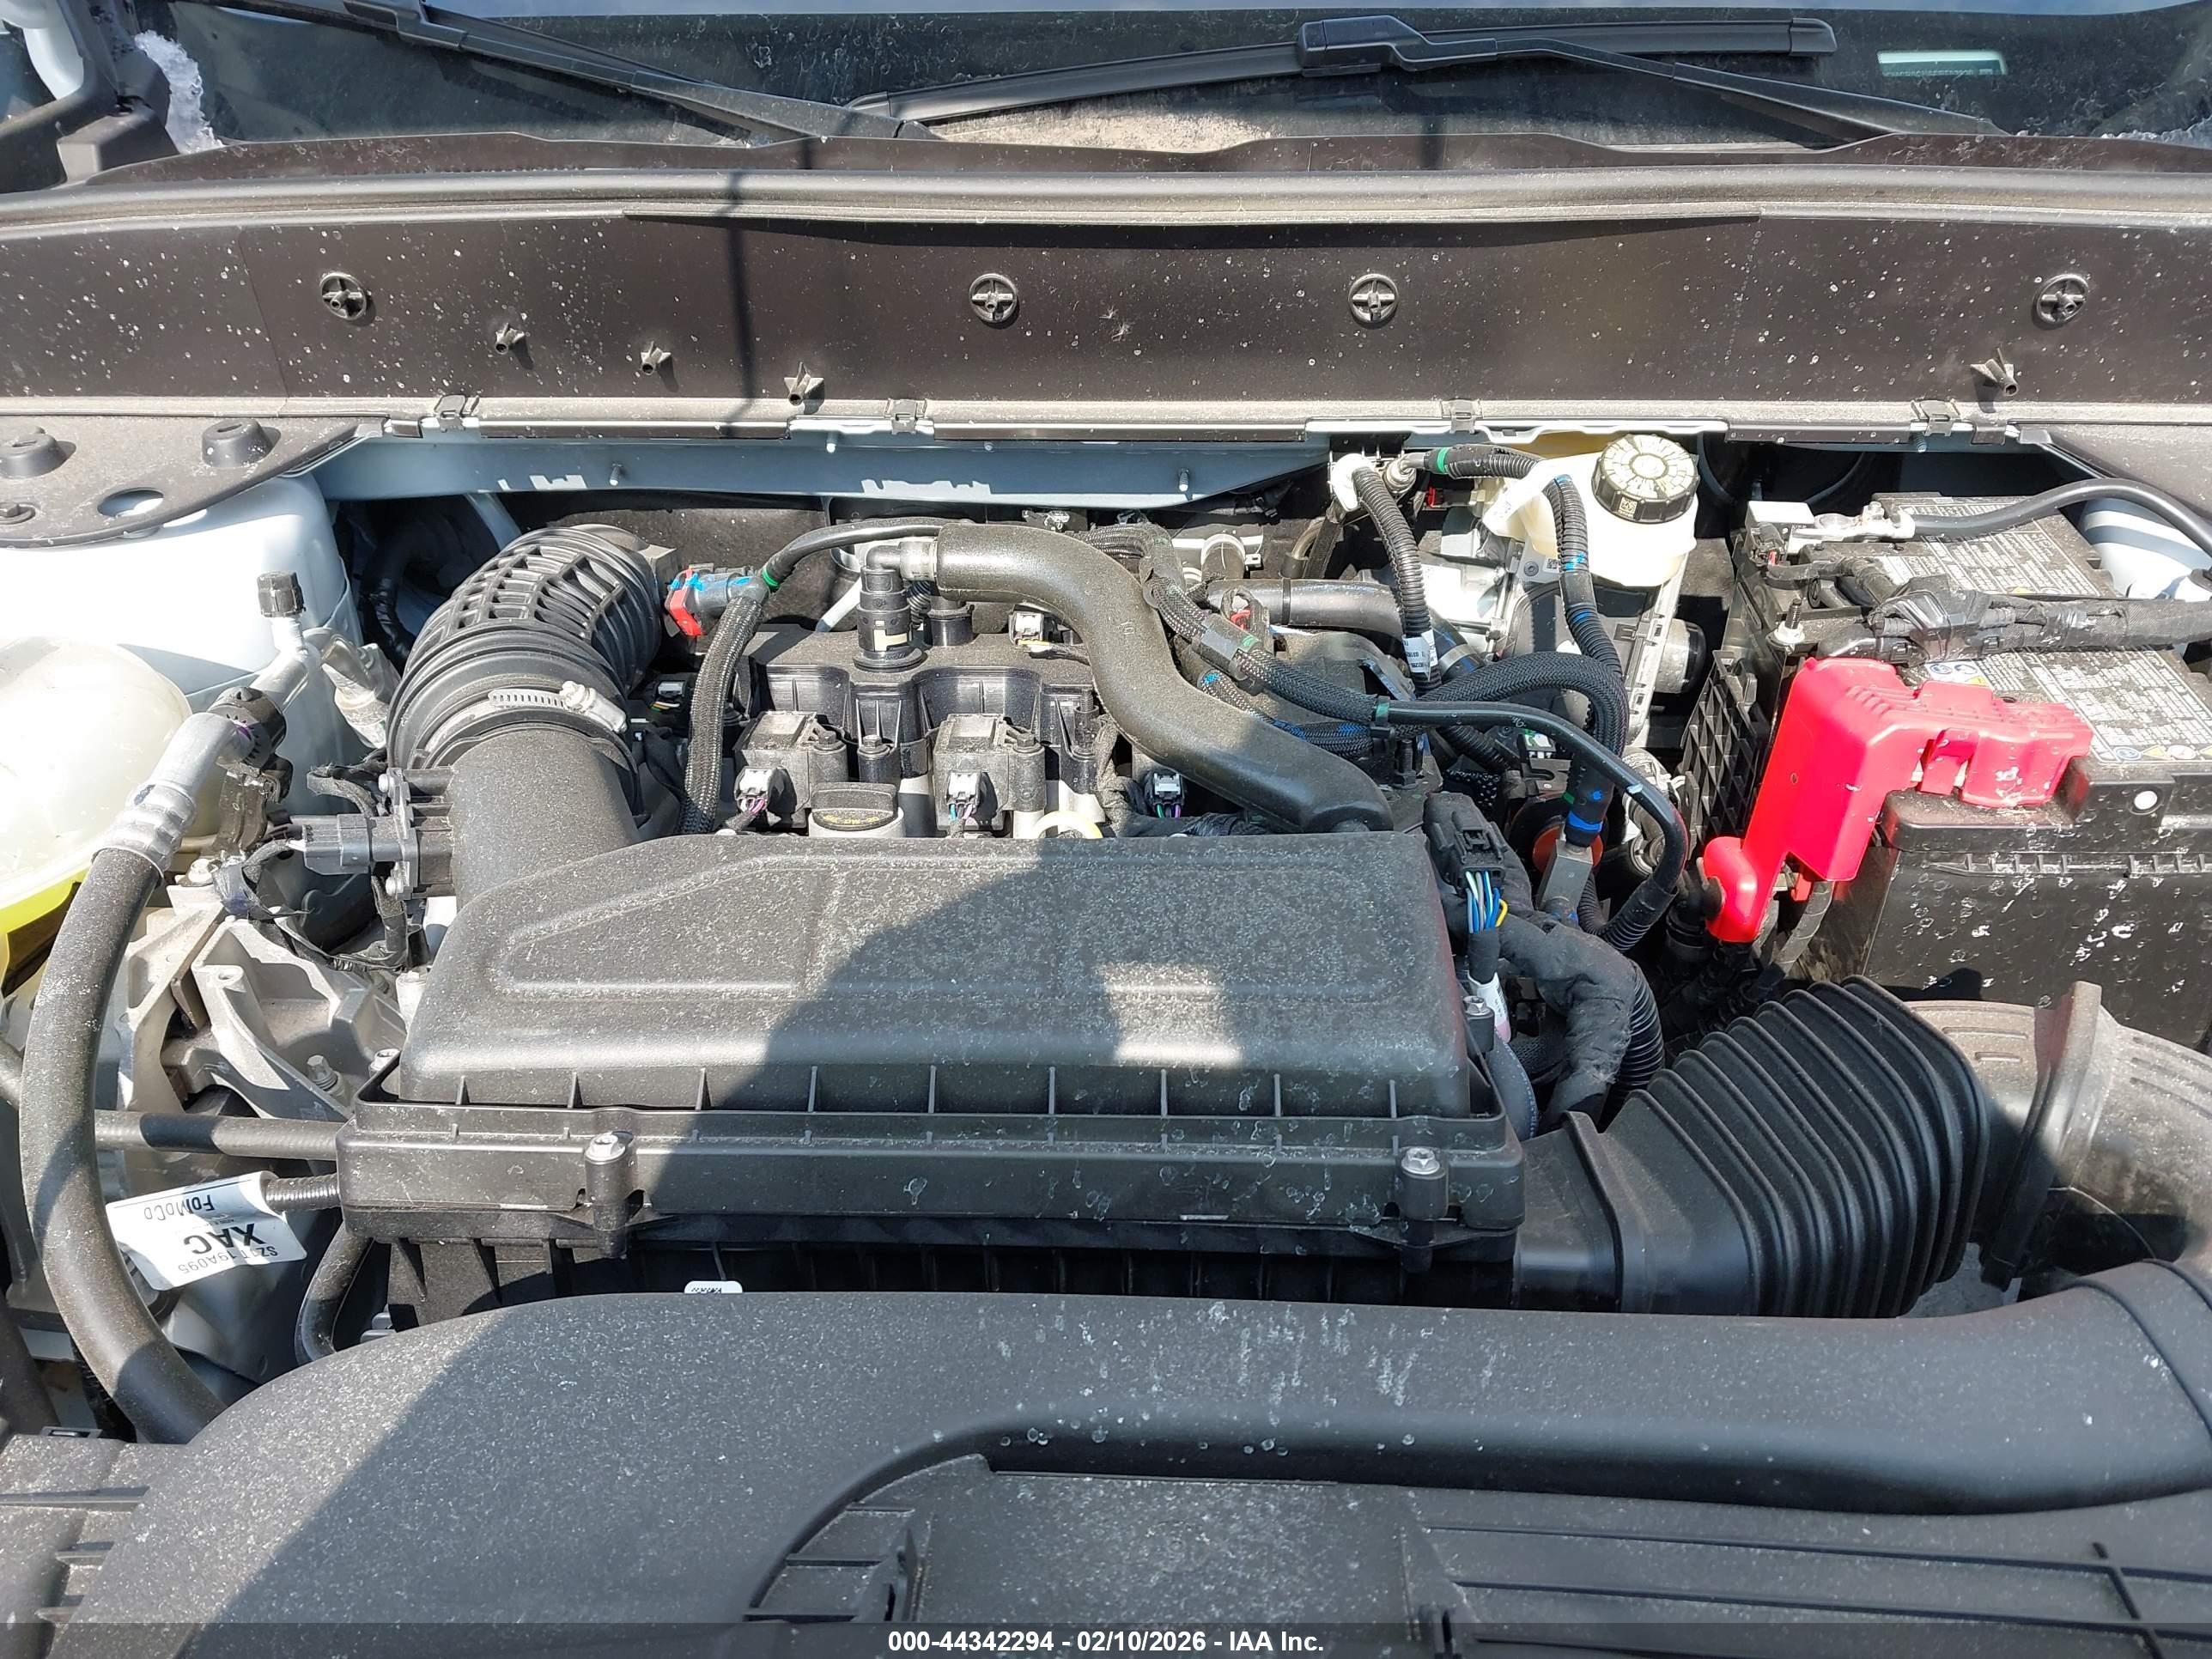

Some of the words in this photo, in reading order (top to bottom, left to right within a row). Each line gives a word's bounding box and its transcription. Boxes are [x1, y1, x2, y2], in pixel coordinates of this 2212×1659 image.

[143, 1194, 215, 1220] FoMoCo
[183, 1224, 267, 1255] XAC
[178, 1250, 237, 1274] 19A095
